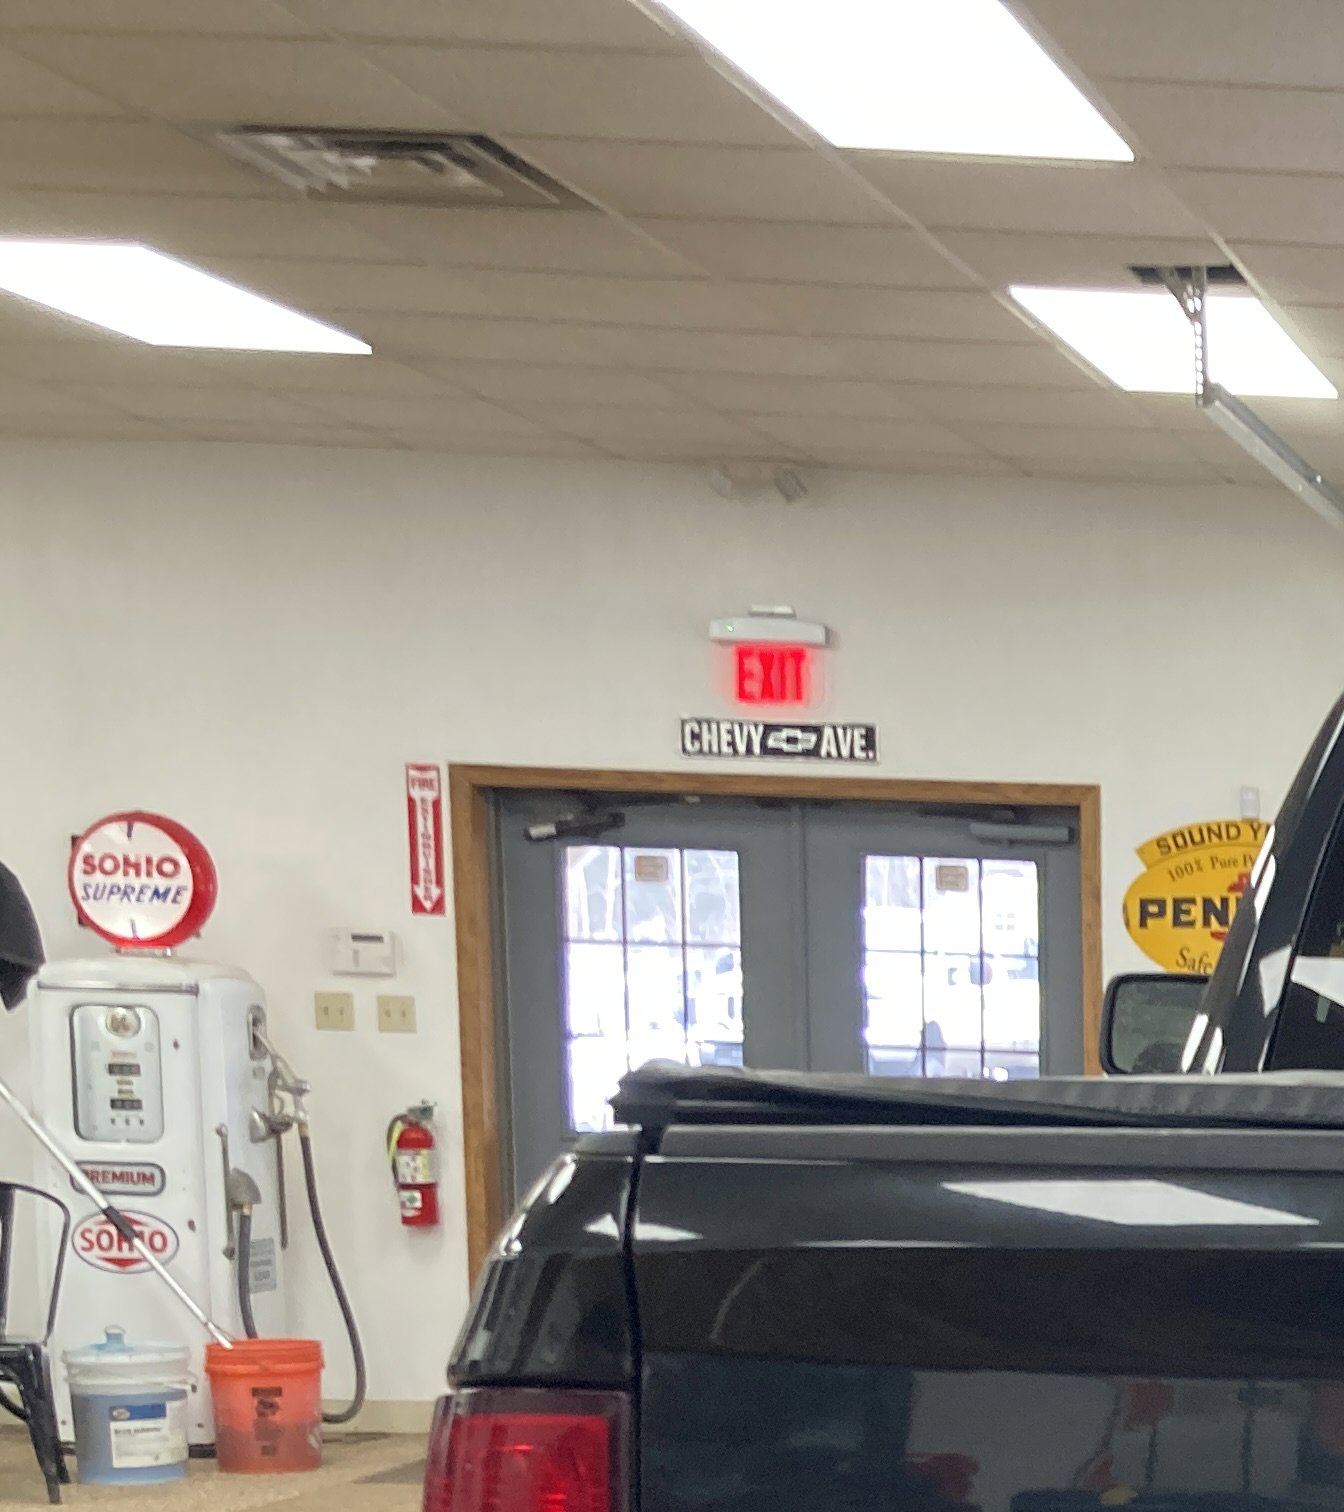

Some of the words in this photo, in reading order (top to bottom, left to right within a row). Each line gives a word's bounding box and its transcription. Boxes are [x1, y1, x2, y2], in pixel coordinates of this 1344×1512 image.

[737, 647, 806, 702] EXIT
[683, 720, 764, 756] CHEVY
[820, 725, 874, 760] AVE.
[1156, 823, 1241, 855] SOUND
[1249, 822, 1272, 842] Y
[82, 852, 181, 878] SOHIO
[1210, 855, 1239, 870] Pure
[81, 883, 188, 904] SUPREME
[1139, 897, 1242, 928] PEN
